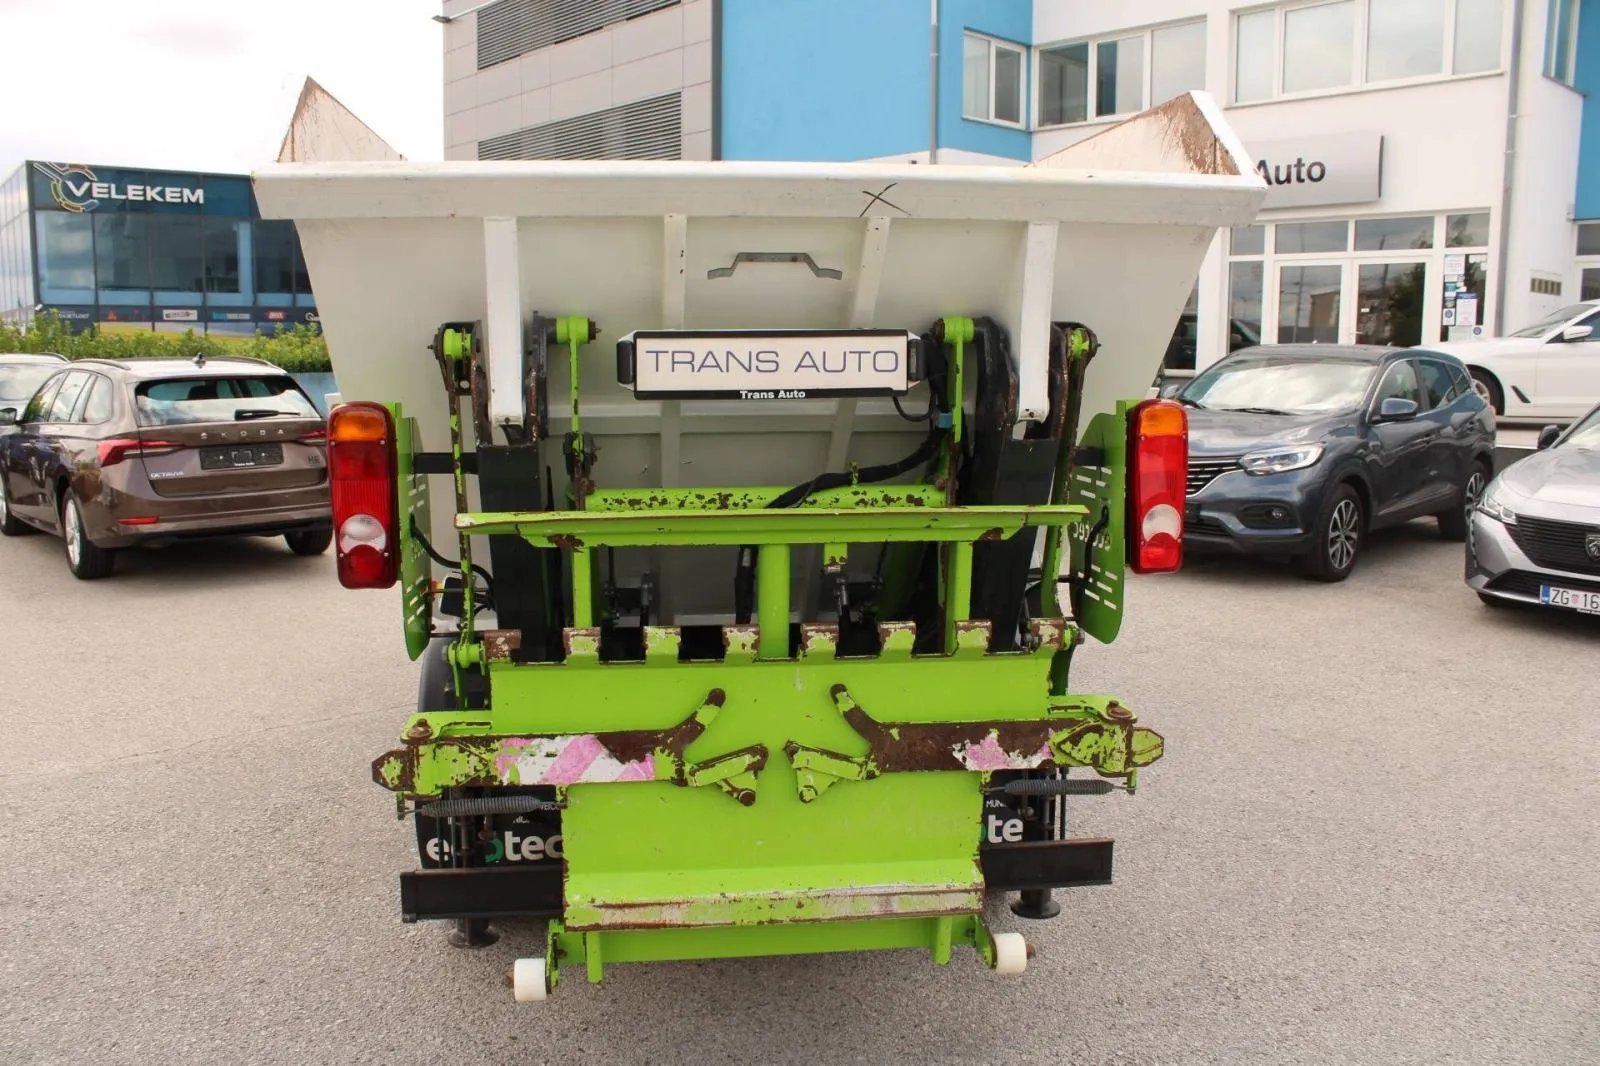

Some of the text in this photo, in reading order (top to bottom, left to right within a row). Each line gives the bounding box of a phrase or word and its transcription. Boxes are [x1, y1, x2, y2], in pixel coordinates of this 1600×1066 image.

[1256, 157, 1326, 185] Auto
[65, 180, 204, 204] VELEKEM
[646, 350, 899, 373] TRANS AUTO
[739, 388, 806, 399] Trans Auto
[1551, 589, 1600, 609] ZG 16
